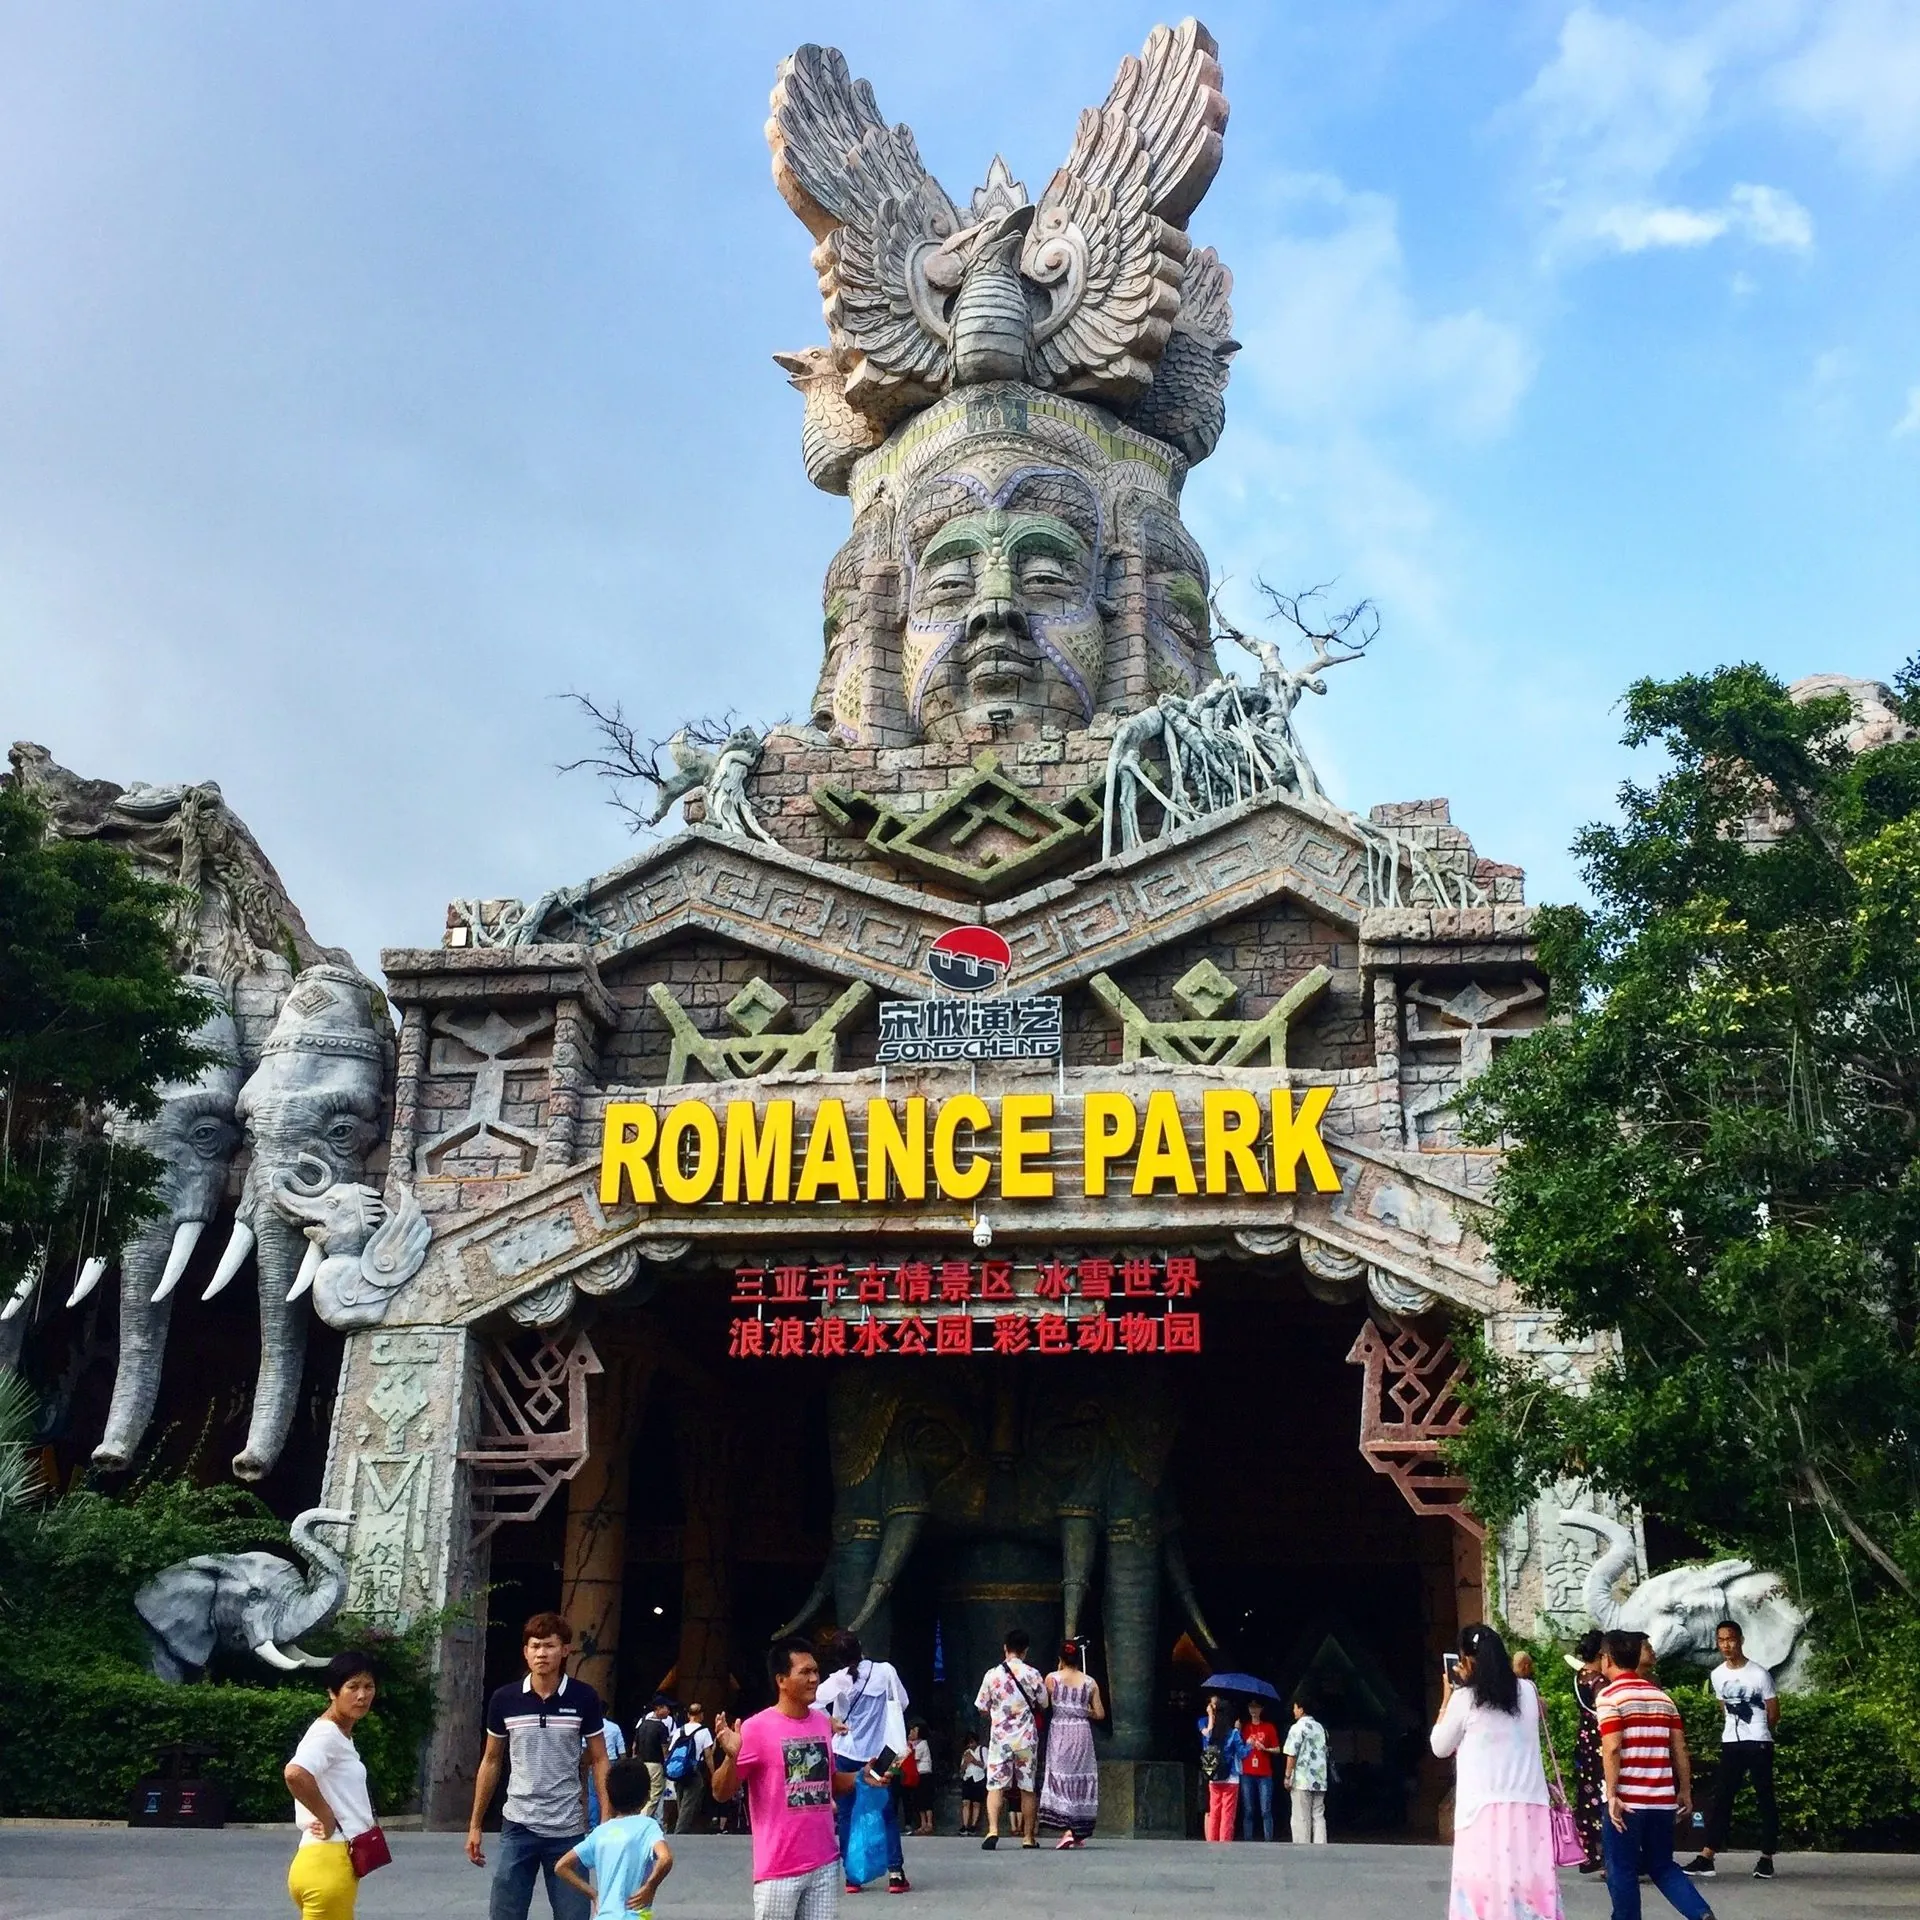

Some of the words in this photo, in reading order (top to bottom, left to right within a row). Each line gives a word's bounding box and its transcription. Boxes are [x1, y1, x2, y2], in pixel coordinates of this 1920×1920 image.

[879, 997, 1060, 1040] 宋城演艺
[876, 1037, 1061, 1062] SONGCHENG
[600, 1093, 1054, 1204] ROMANCE
[1083, 1086, 1343, 1197] PARK
[731, 1259, 1016, 1305] 三亚千古情景区
[1034, 1256, 1200, 1299] 冰雪世界
[728, 1315, 973, 1358] 浪浪浪水公园
[992, 1311, 1200, 1355] 彩色动物园
